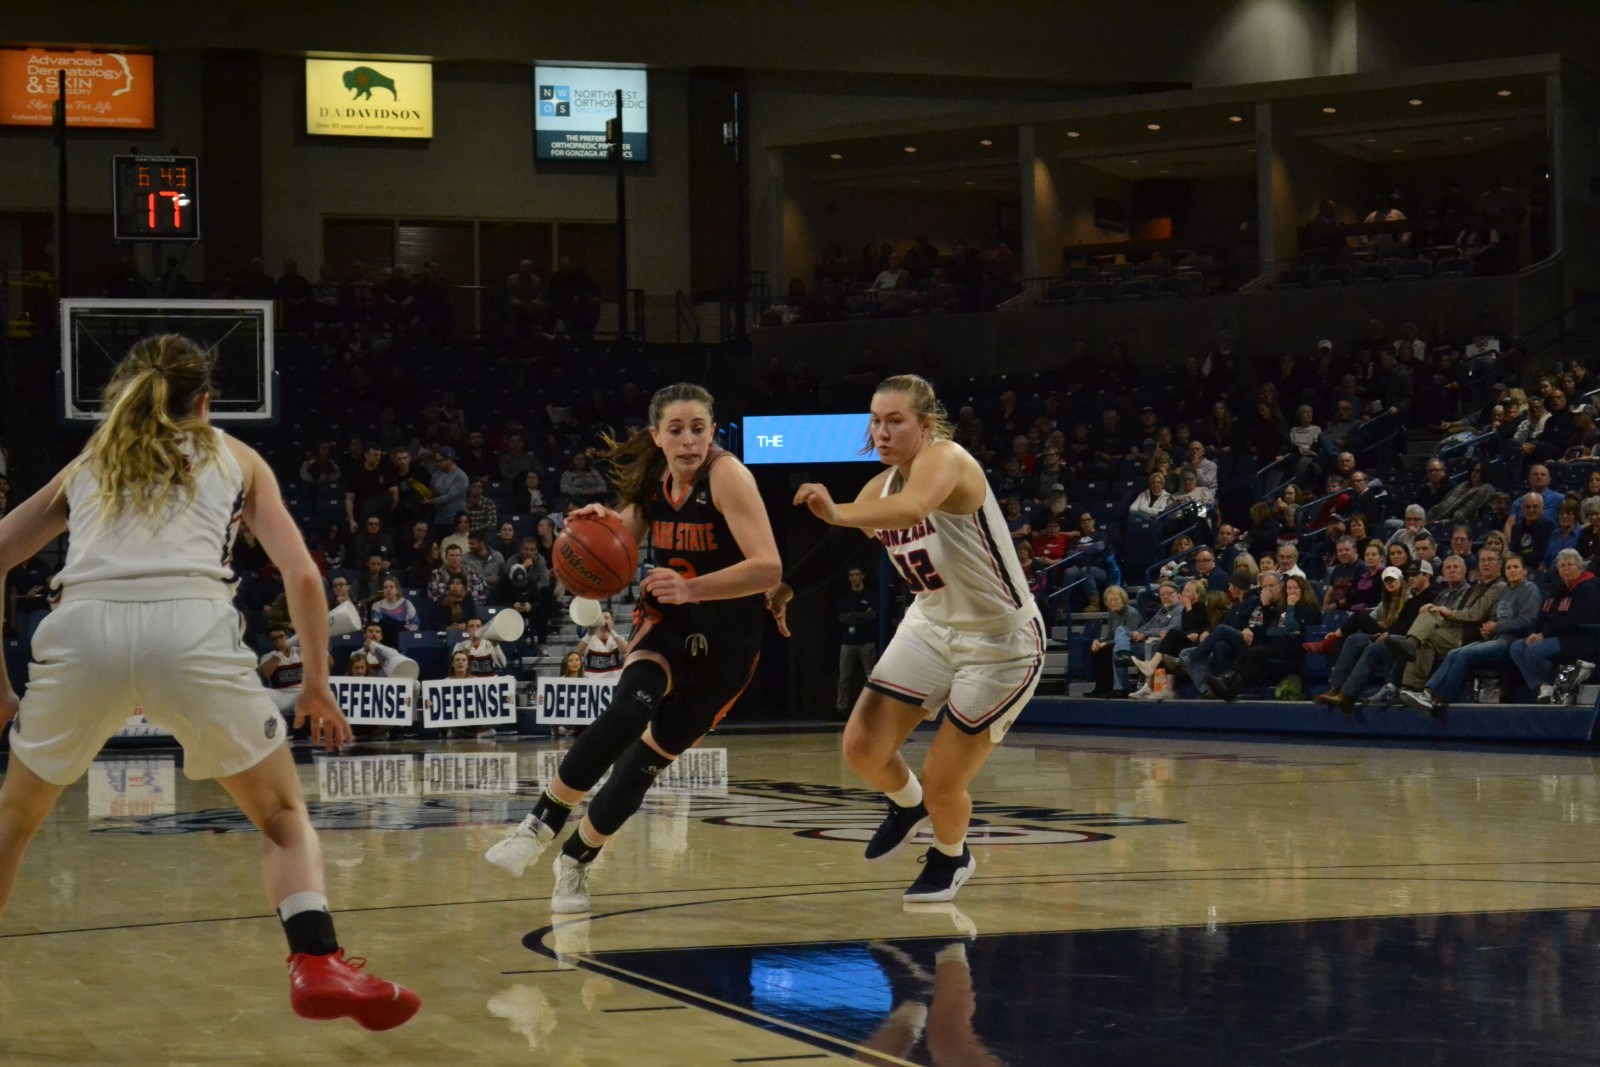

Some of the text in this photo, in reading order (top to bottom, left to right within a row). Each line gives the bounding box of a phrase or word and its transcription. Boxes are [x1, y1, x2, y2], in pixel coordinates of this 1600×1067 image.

[28, 55, 103, 66] Advanced
[27, 76, 44, 94] &
[346, 108, 421, 119] DAVIDSON
[574, 99, 645, 108] ORTHOPEDIC
[565, 149, 597, 157] GONZAGA
[148, 190, 181, 229] 17
[757, 435, 783, 447] THE
[676, 522, 718, 551] STATE
[878, 517, 937, 547] ONZAGA
[561, 541, 602, 586] Wilson
[893, 548, 945, 592] 12
[429, 683, 510, 721] DEFENSE
[544, 684, 618, 718] DEFENS
